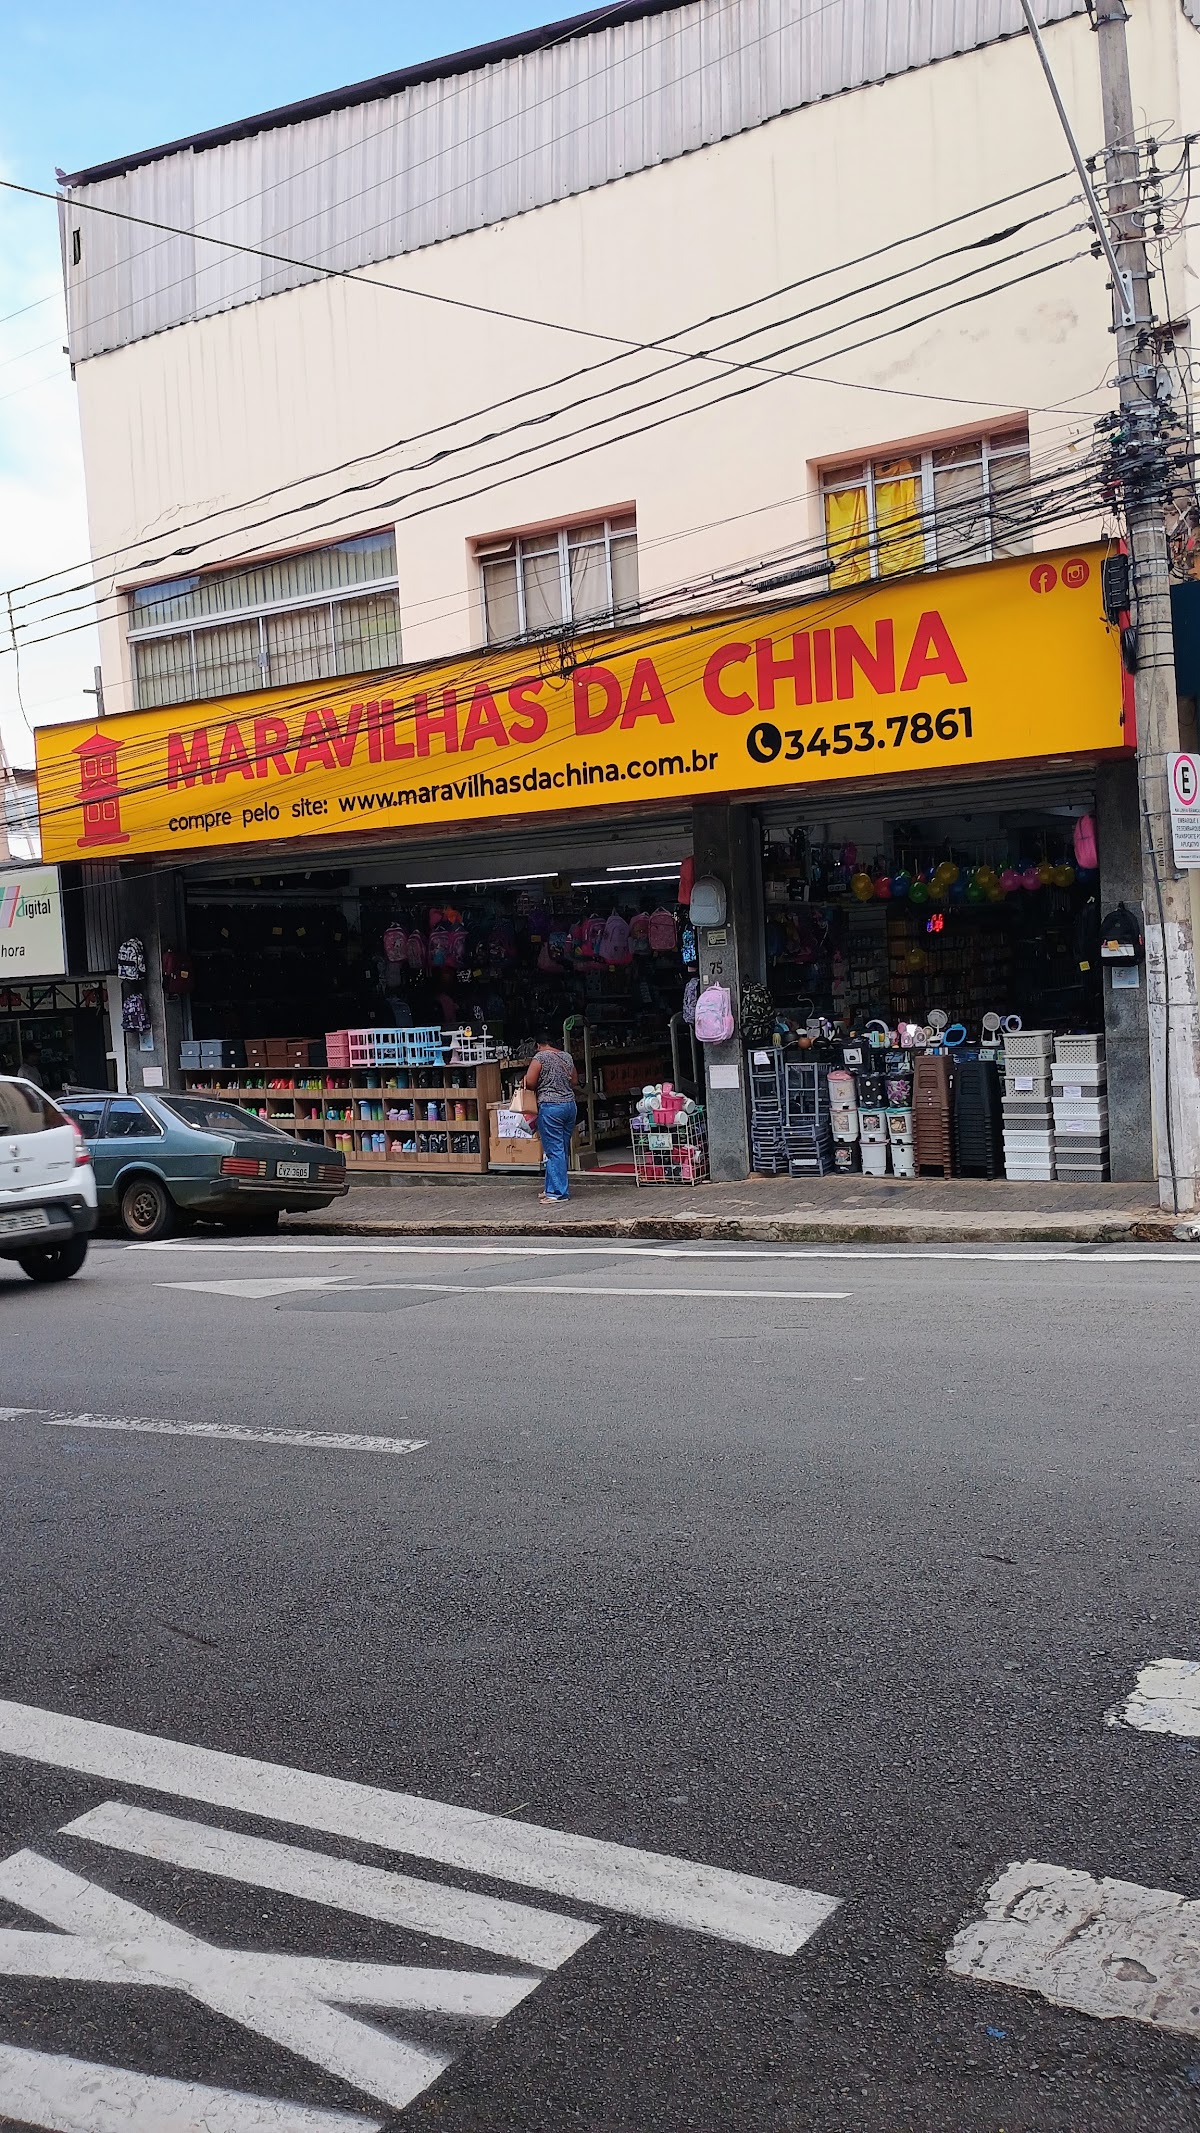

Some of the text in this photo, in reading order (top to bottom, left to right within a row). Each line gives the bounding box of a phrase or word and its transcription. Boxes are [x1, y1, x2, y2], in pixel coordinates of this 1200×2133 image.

[167, 610, 968, 790] MARAVILHAS DA CHINA
[784, 706, 973, 760] 3453.7861
[168, 749, 719, 832] compre pelo site: www.maravilhasdachina.com.br
[1181, 766, 1191, 794] E
[16, 894, 51, 919] digital
[1, 944, 26, 957] hora
[709, 960, 723, 975] 75
